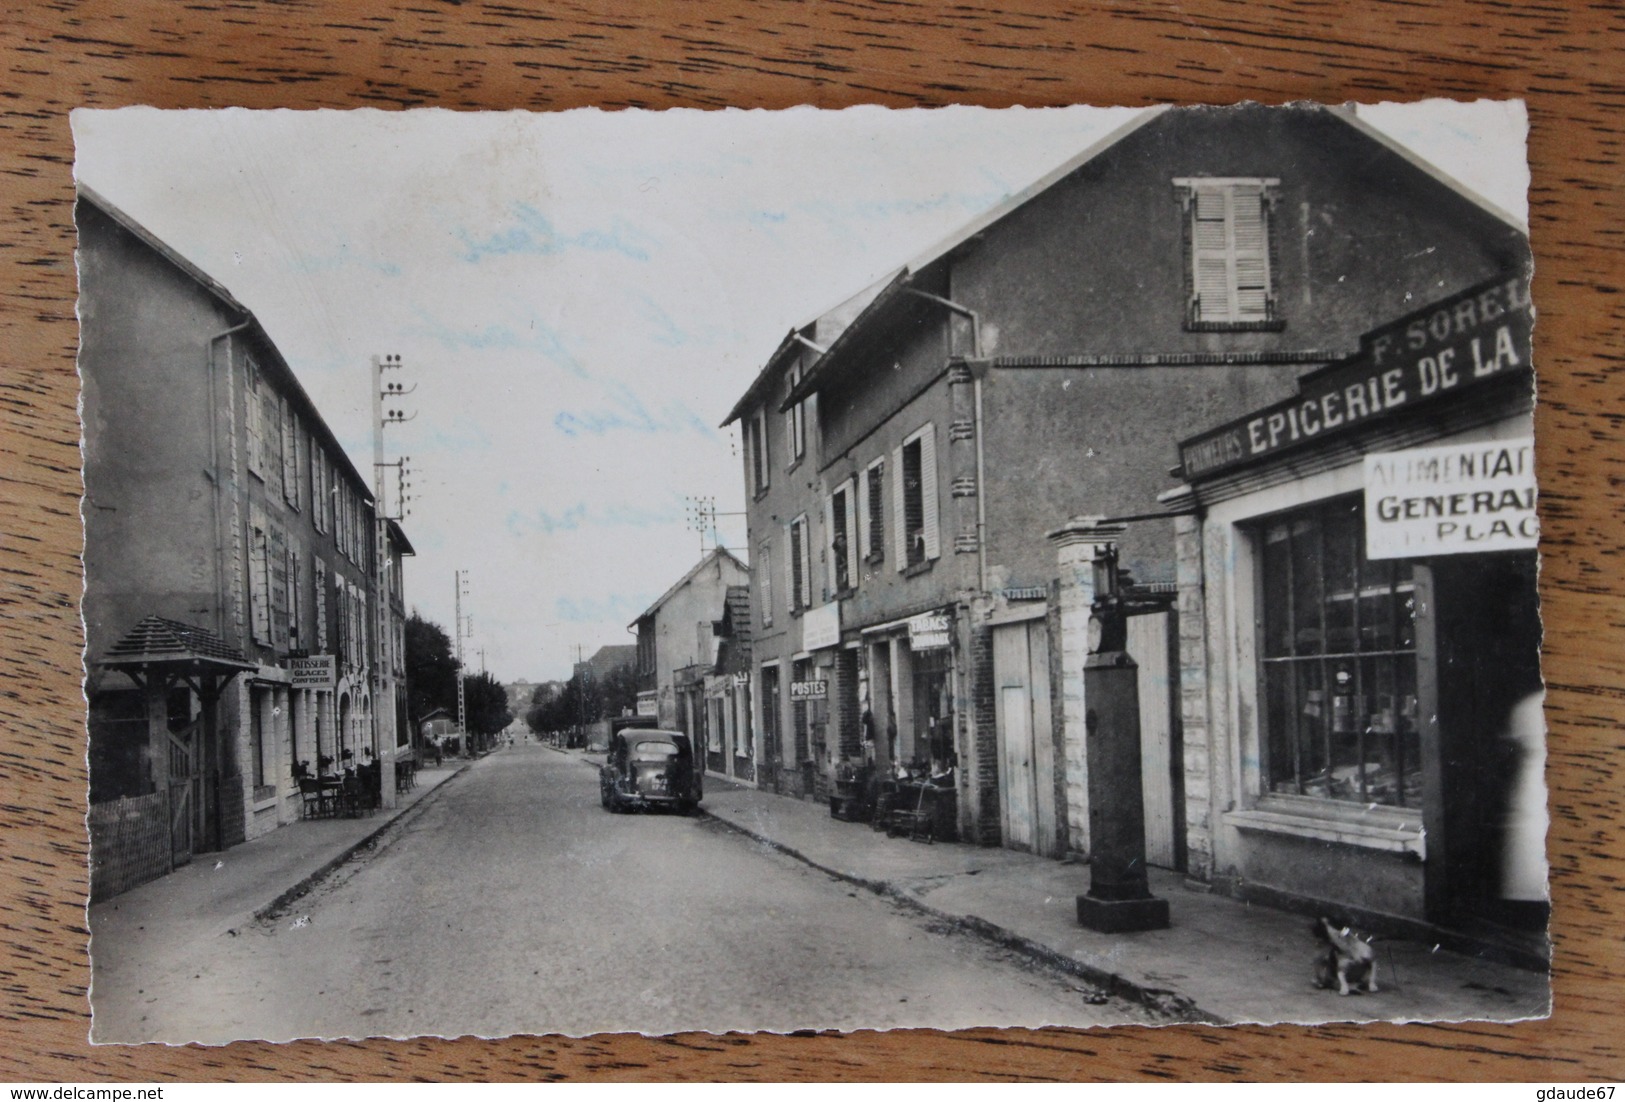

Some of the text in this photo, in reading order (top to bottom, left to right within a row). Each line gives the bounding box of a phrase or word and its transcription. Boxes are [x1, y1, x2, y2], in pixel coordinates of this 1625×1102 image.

[1247, 368, 1406, 454] EPICERIE
[1418, 347, 1458, 396] DE
[1471, 325, 1519, 377] LA
[911, 616, 948, 633] TABACS
[291, 660, 330, 669] PATISSERIE
[294, 669, 328, 677] GLACES
[292, 676, 330, 684] CONFISERIE
[791, 681, 826, 695] POSTES
